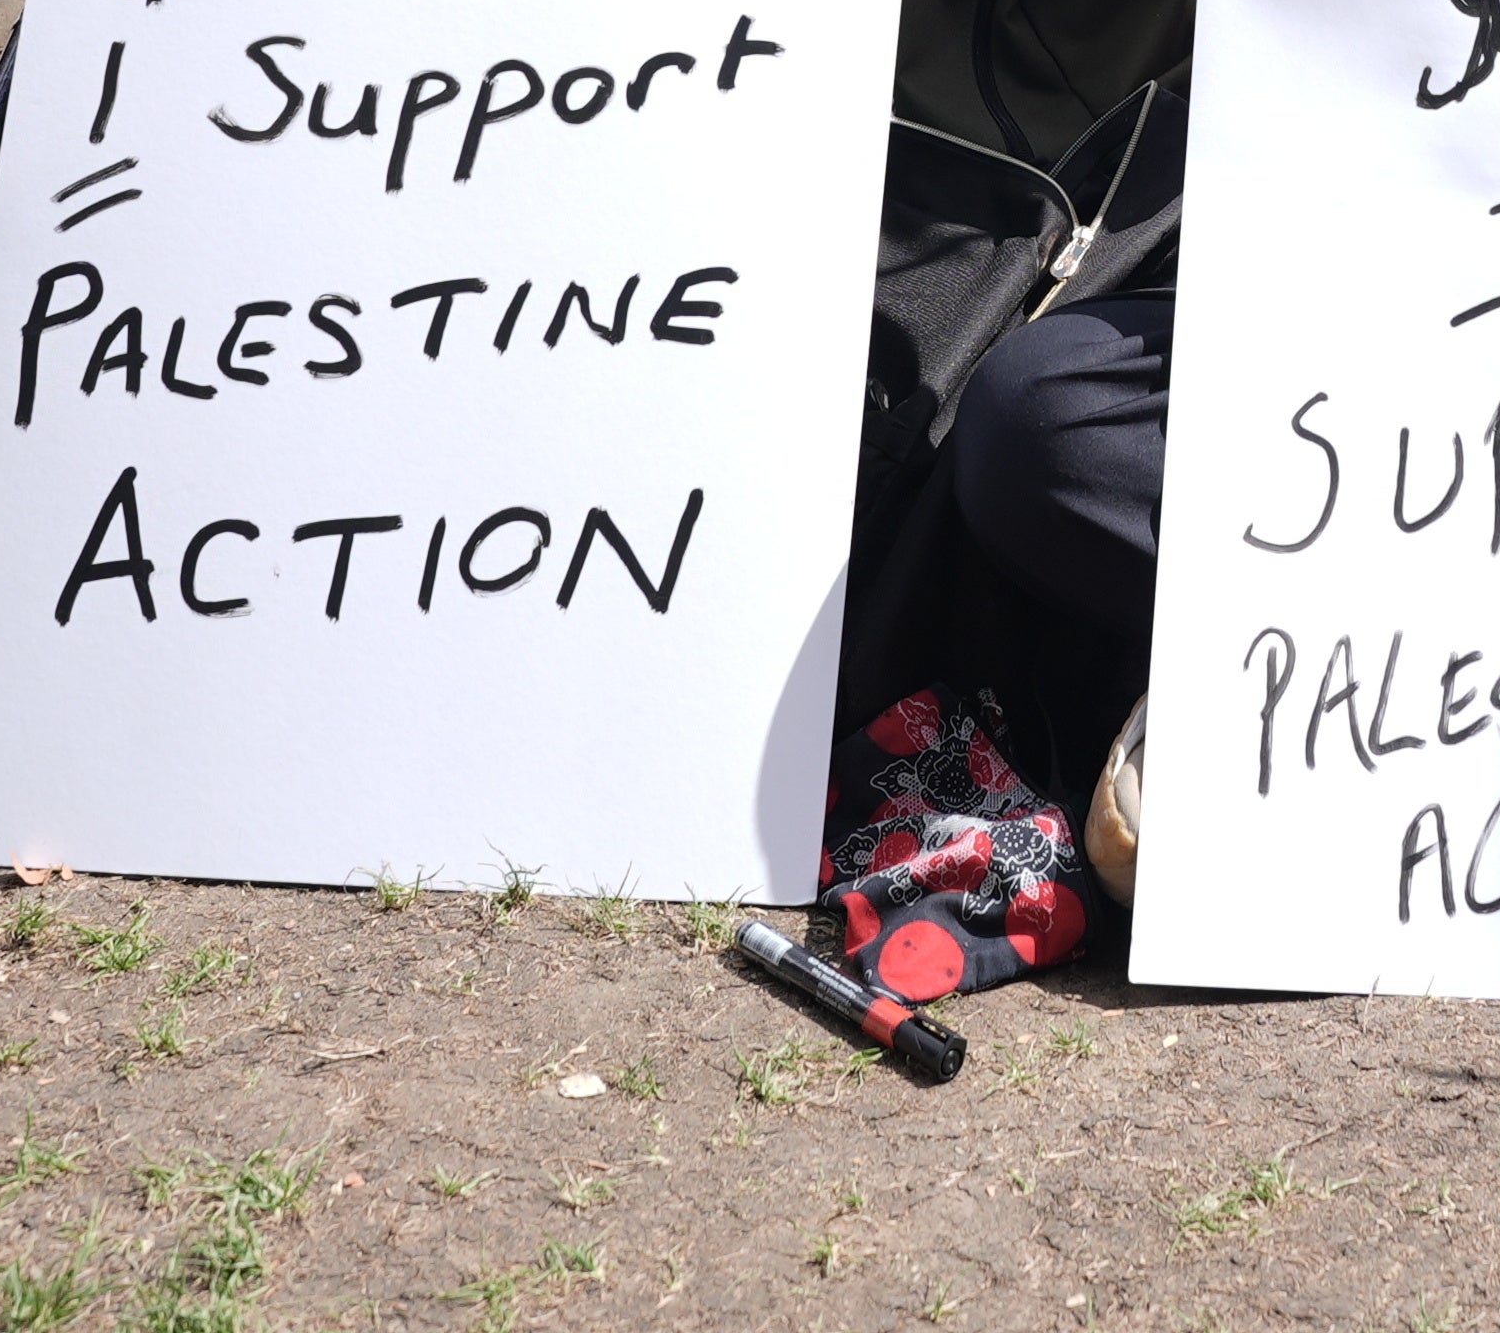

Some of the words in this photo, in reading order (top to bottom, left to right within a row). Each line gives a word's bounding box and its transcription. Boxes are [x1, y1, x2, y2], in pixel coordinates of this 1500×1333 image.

[88, 40, 126, 144] I
[14, 260, 739, 430] PALESTINE
[55, 466, 704, 628] ACTION
